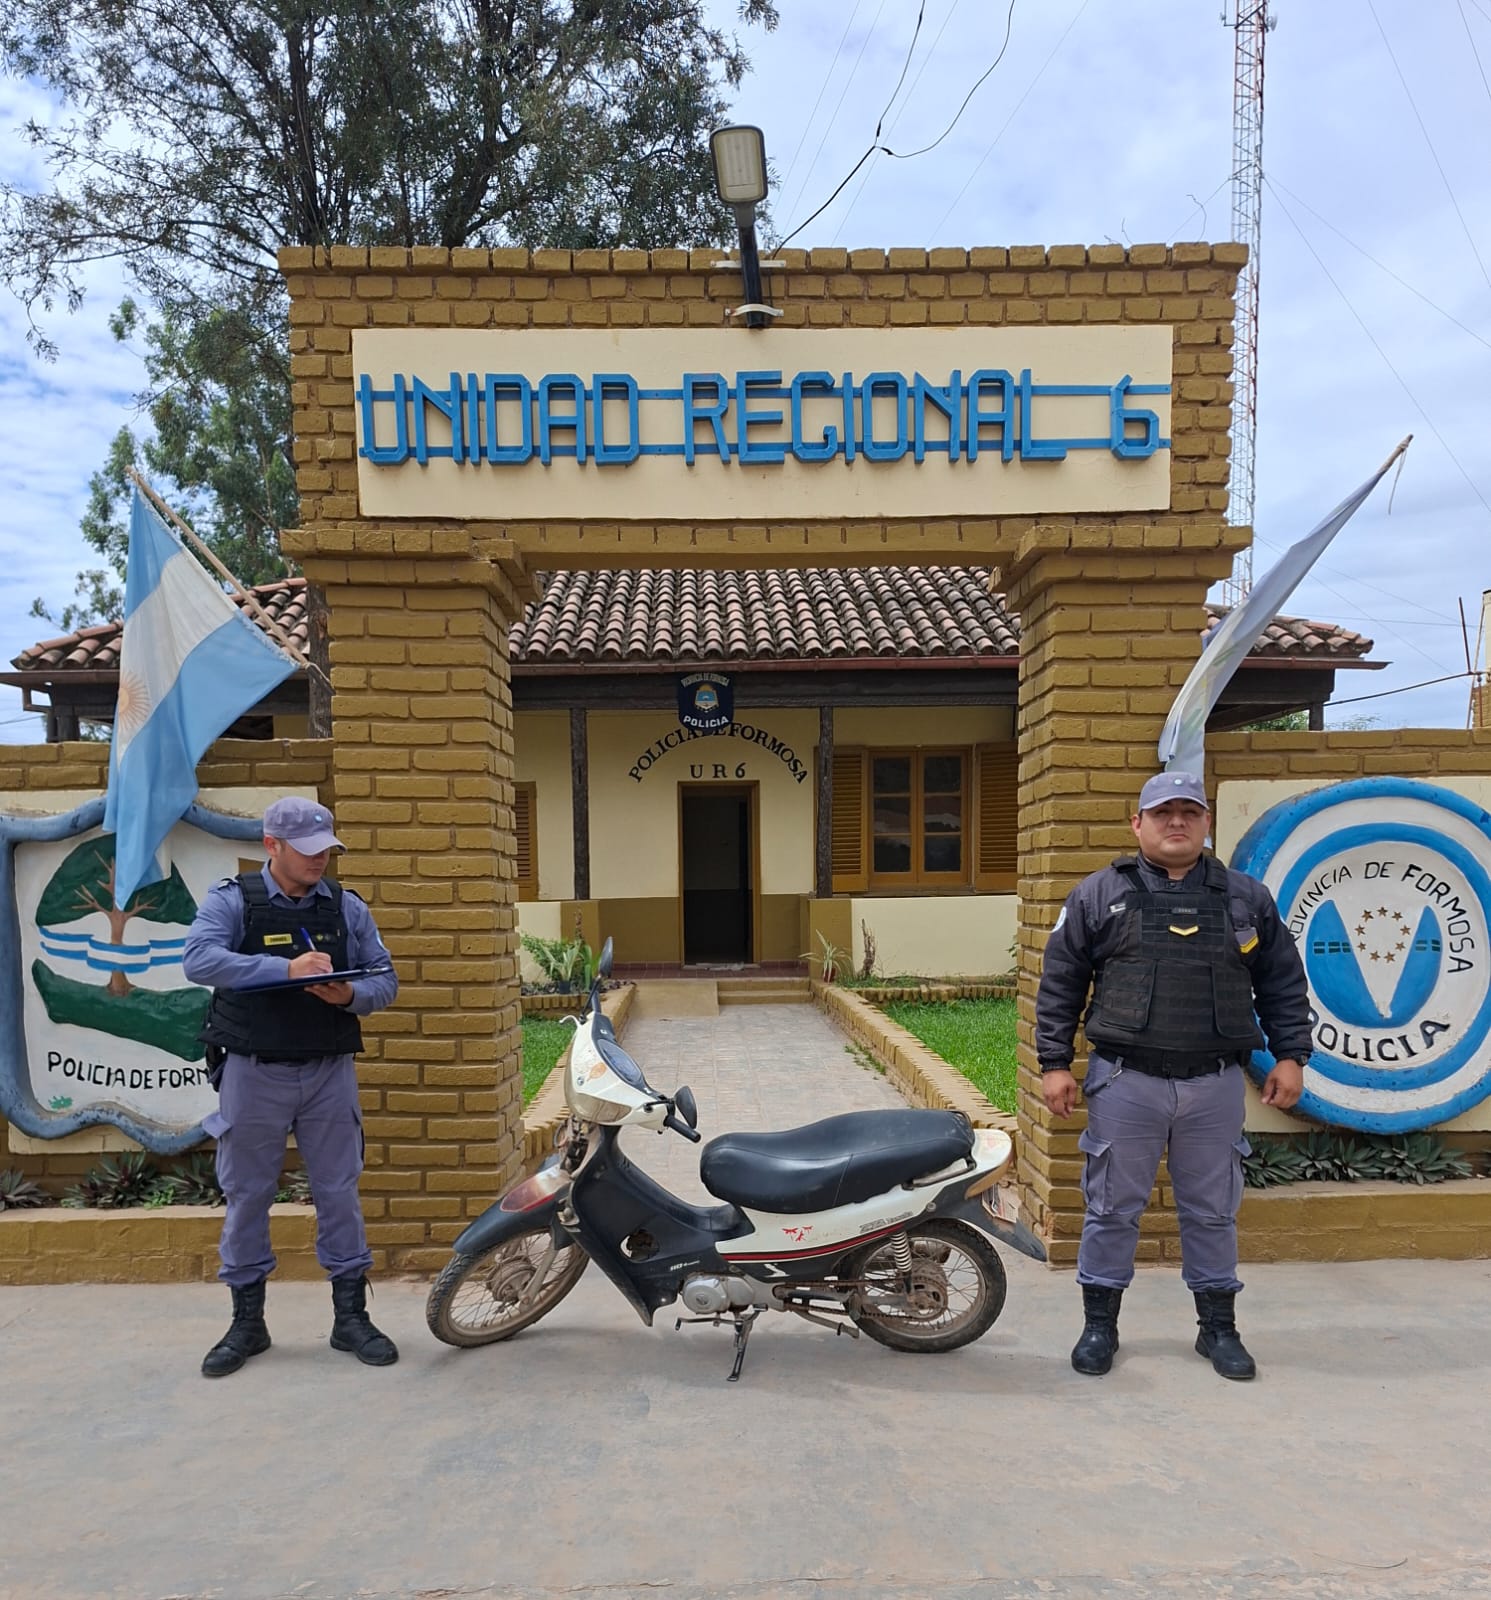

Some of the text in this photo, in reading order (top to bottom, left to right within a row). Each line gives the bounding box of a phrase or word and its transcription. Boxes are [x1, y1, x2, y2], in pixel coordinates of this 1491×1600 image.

[359, 368, 1160, 466] UNIDAD REGIONAL 6
[683, 715, 729, 728] POLICIA
[727, 722, 808, 784] FORMOSA
[1364, 862, 1395, 879] DE
[1401, 864, 1475, 973] FORMOSA
[48, 1051, 126, 1088] POLICIA
[129, 1069, 153, 1089] DE
